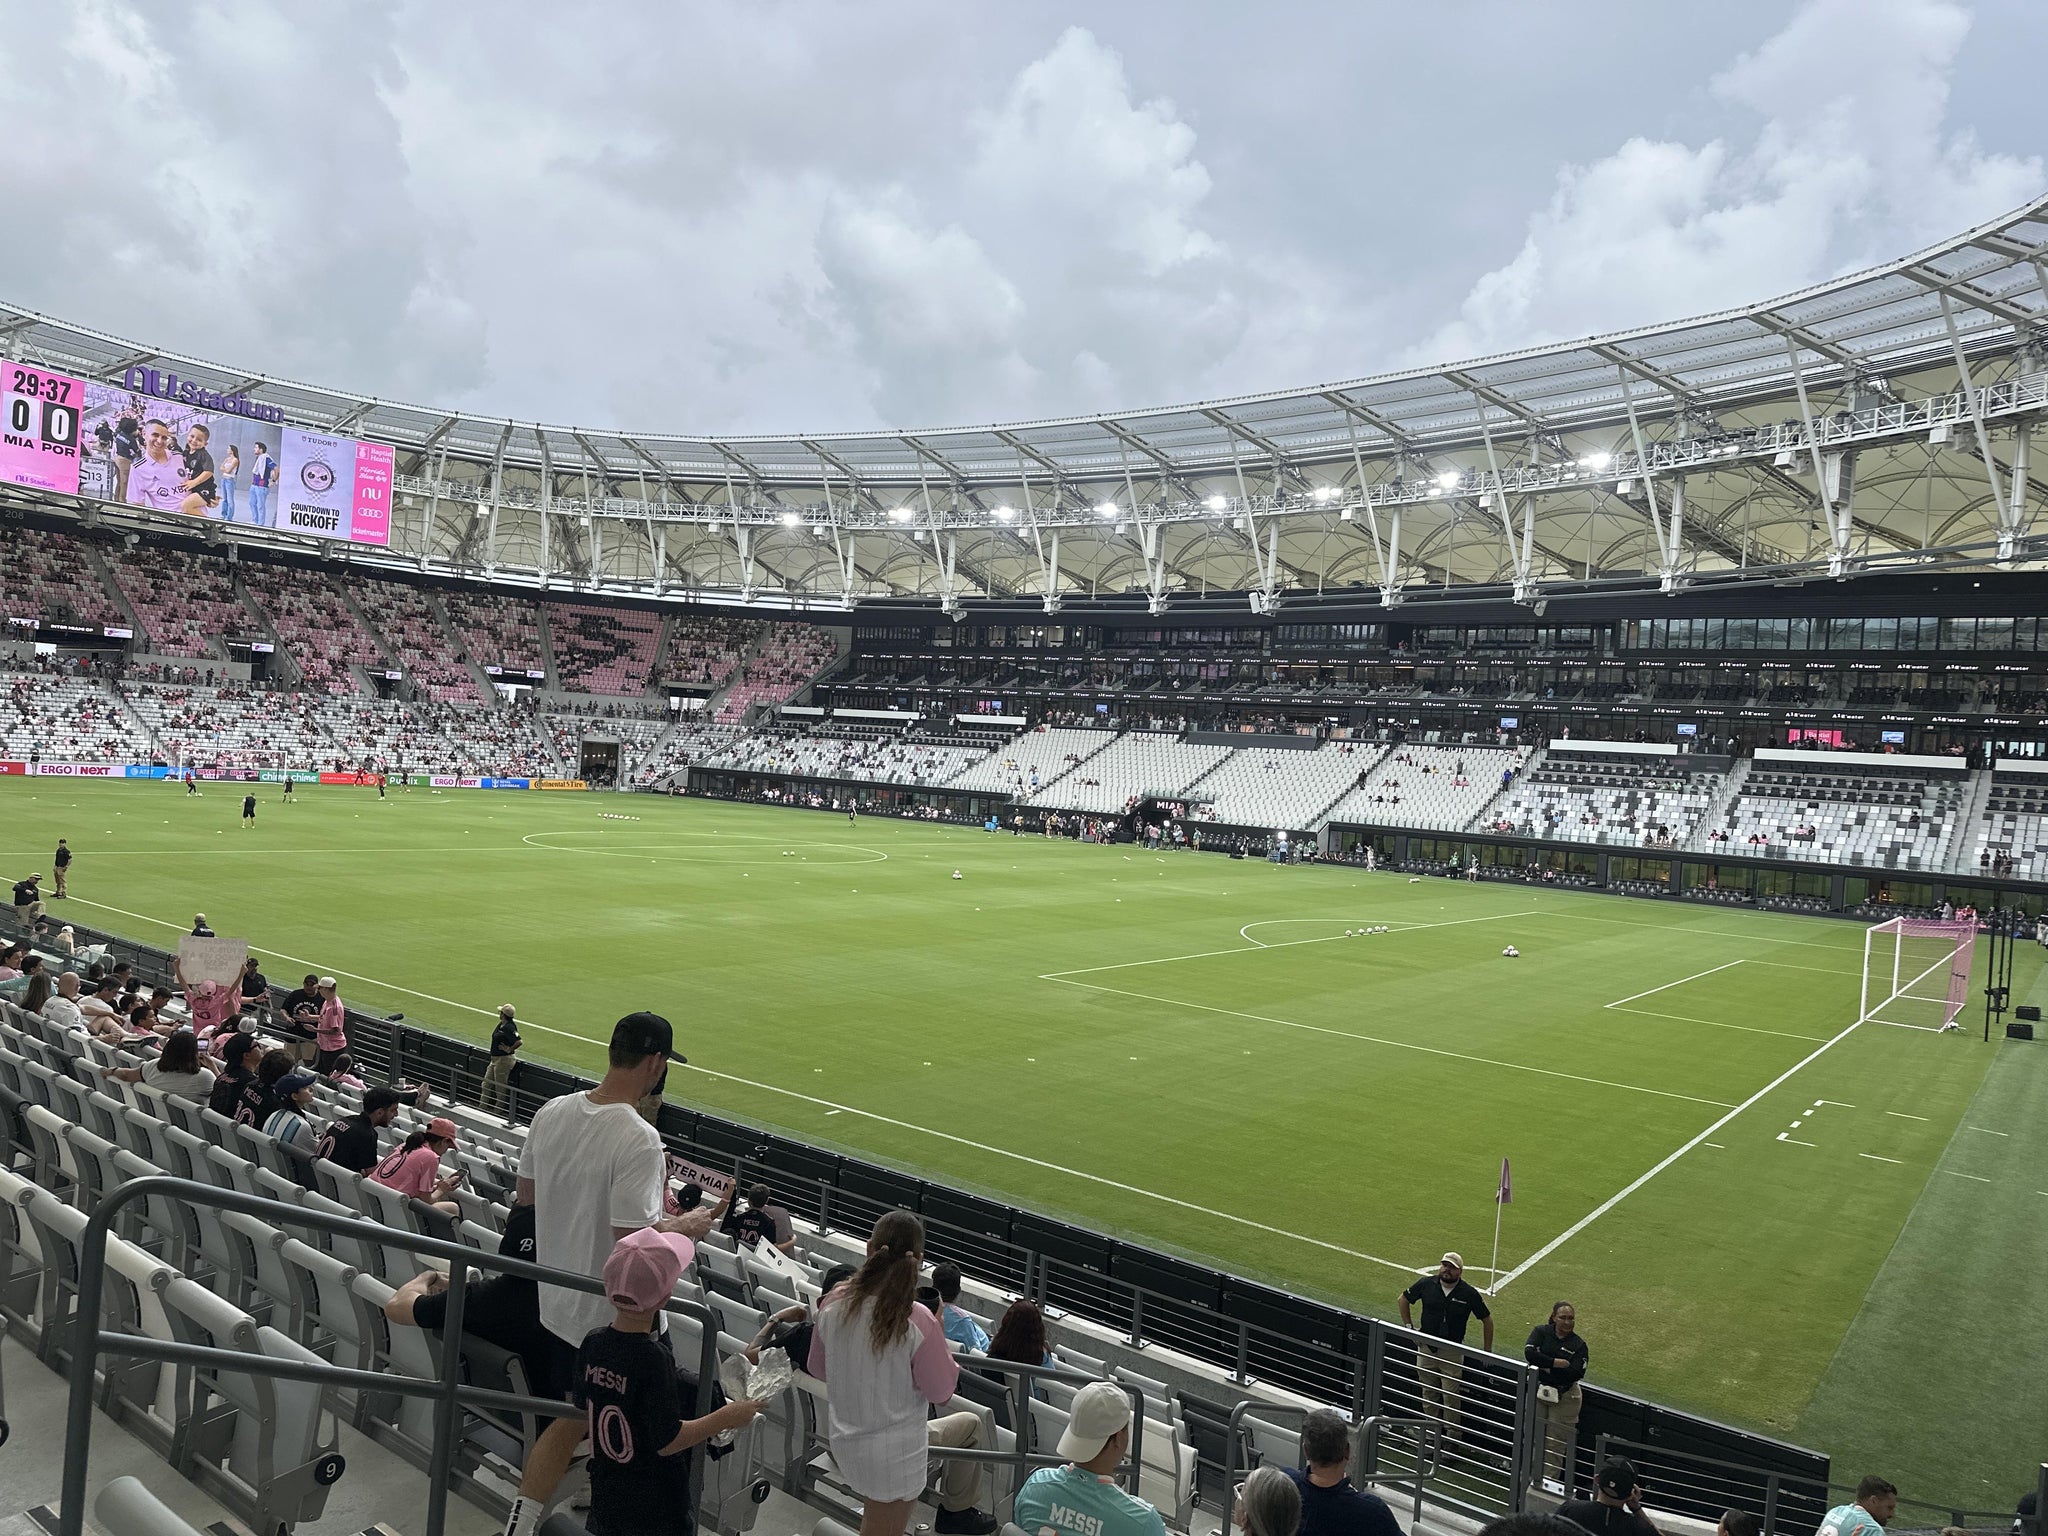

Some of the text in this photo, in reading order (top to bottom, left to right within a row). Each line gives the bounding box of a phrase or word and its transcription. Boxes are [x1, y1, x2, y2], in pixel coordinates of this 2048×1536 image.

[13, 370, 71, 404] 29:37
[181, 381, 285, 423] Stadium
[12, 399, 29, 432] 0
[51, 408, 69, 441] 0
[4, 434, 34, 449] MIA
[308, 438, 332, 447] TUDOR
[42, 442, 75, 457] POR
[5, 510, 24, 520] 208
[291, 502, 340, 517] COUNTDOWN TO
[290, 511, 339, 531] KICKOFF
[146, 532, 162, 541] 207
[269, 550, 284, 559] 206
[41, 765, 72, 775] ERGO
[434, 778, 455, 786] ERGO
[243, 1086, 263, 1105] MESSI
[519, 1238, 534, 1252] B
[584, 1363, 627, 1395] MESSI
[586, 1398, 634, 1464] 10
[326, 1462, 337, 1478] 9
[1049, 1502, 1104, 1536] MESSI
